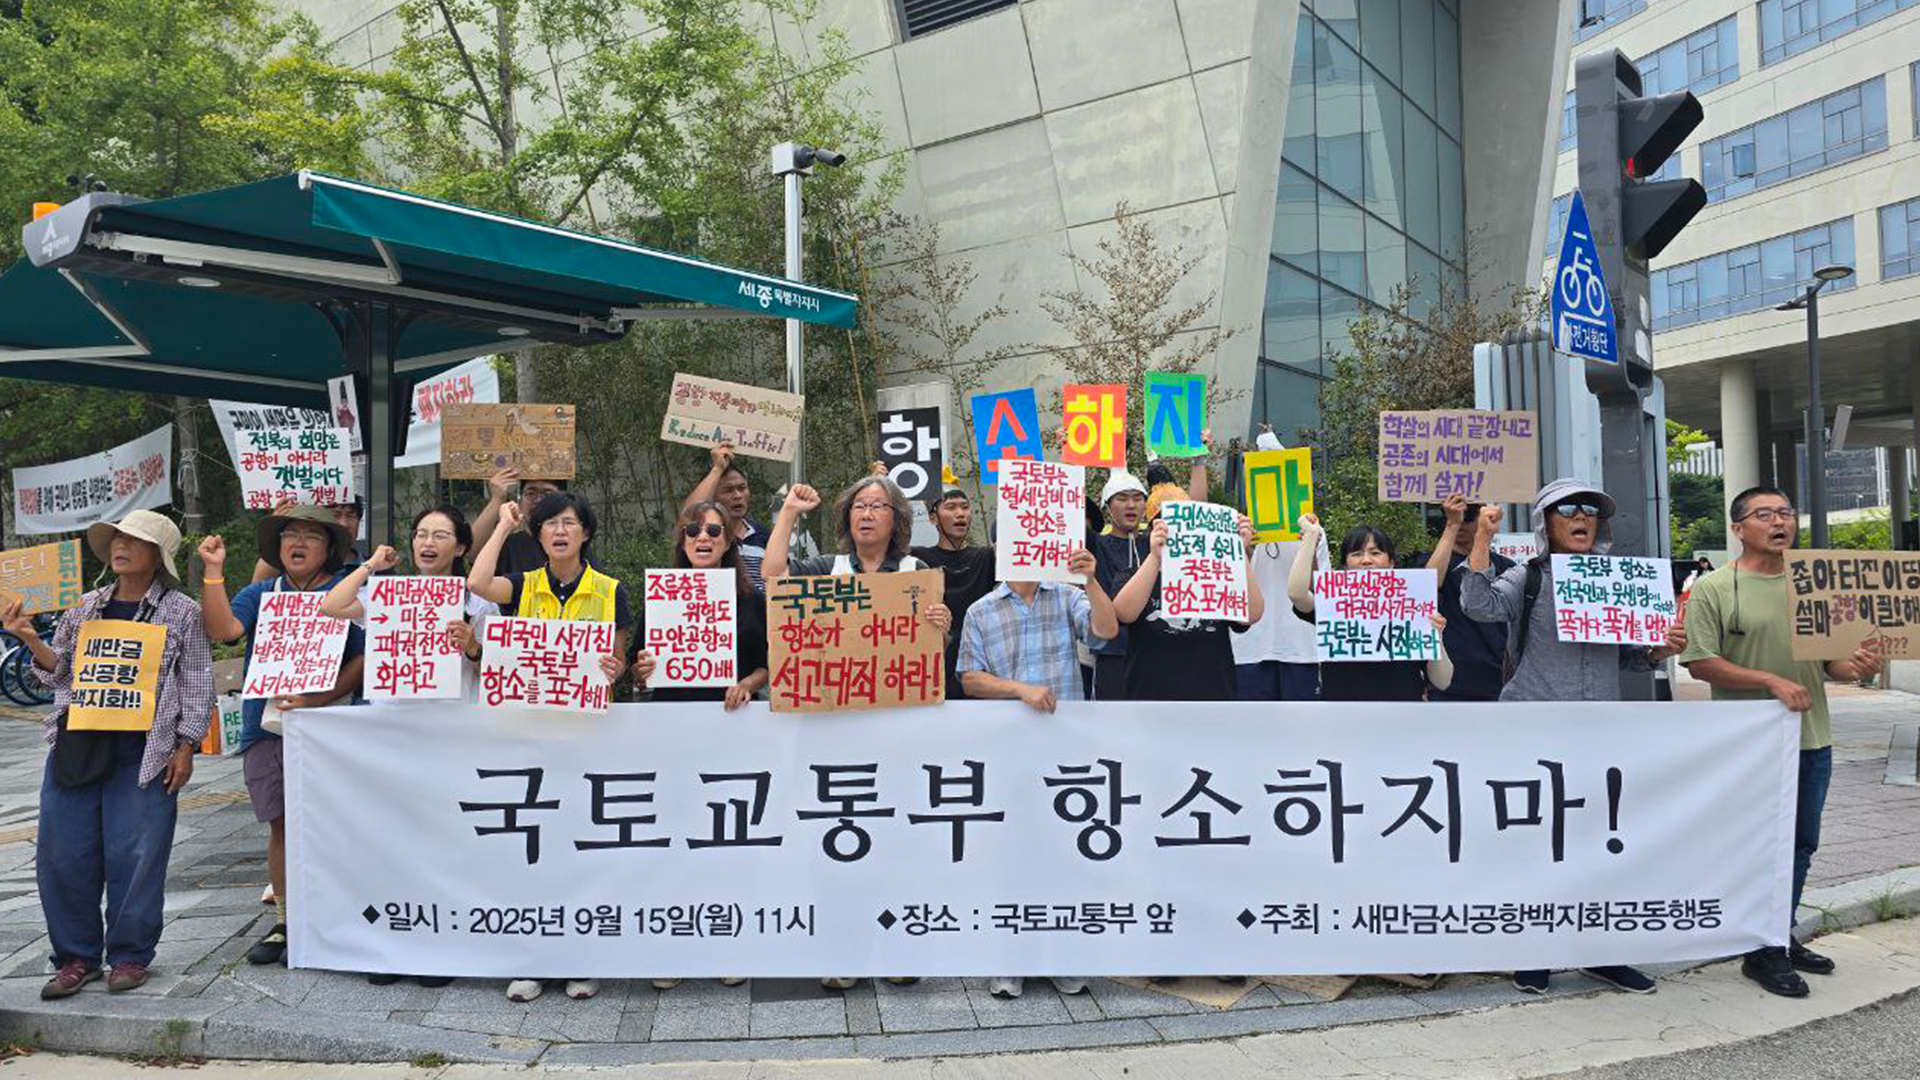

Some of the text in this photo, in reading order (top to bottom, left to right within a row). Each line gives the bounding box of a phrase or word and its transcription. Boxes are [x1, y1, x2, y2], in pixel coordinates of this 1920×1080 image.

[1066, 394, 1124, 460] 하
[1150, 380, 1202, 448] 지
[1383, 414, 1533, 439] 학살의 시대 끝장내고
[248, 431, 291, 450] 전북의
[298, 431, 340, 450] 희망은
[668, 418, 709, 442] Reduce
[736, 429, 786, 454] Traffic!
[986, 398, 1034, 472] 소
[240, 450, 327, 470] 공항이 아니라
[881, 413, 940, 498] 항
[1382, 443, 1504, 467] 공존의 시대에서
[272, 465, 343, 489] 갯벌이다
[1010, 461, 1068, 486] 국토부는
[1384, 471, 1485, 499] 함께 살자!
[999, 483, 1064, 510] 혈세낭비
[1250, 459, 1309, 533] 마
[1016, 508, 1067, 538] 항소를
[1166, 533, 1244, 561] 압도적 승리!
[1180, 559, 1234, 582] 국토부는
[1567, 555, 1658, 580] 국토부 항소는
[371, 578, 463, 606] 새만금신공항
[647, 573, 708, 600] 조류충돌
[772, 576, 872, 619] 국토부는
[1315, 571, 1408, 599] 새만금신공항은
[1556, 578, 1610, 604] 전국민과
[682, 600, 732, 624] 위험도
[1602, 606, 1642, 642] 폭거를
[1795, 599, 1832, 637] 설마
[487, 619, 612, 653] 대국민 사기친
[647, 625, 732, 656] 무안공항의
[779, 613, 920, 653] 항소가 아니라
[1317, 620, 1440, 660] 국토부는 사죄하라
[83, 638, 142, 659] 새만금
[254, 638, 325, 664] 발전시키지
[79, 664, 139, 685] 신공항
[294, 654, 340, 675] 않는다!
[373, 657, 437, 695] 화약고
[517, 650, 579, 677] 국토부
[666, 657, 733, 682] 650배
[245, 670, 336, 695] 사기치지 마!
[482, 664, 610, 709] 항소를 포기해!
[772, 652, 941, 708] 석고대죄 하라!
[71, 689, 141, 709] 백지화!!
[459, 758, 1626, 865] 국토교통부 항소하지마!
[384, 902, 439, 934] 일시
[469, 905, 565, 936] 2025년
[575, 904, 623, 936] 9월
[635, 903, 743, 938] 15일(월)
[755, 904, 816, 936] 11시
[901, 903, 960, 936] 장소
[991, 903, 1137, 934] 국토교통부
[1146, 903, 1177, 934] 앞
[1260, 902, 1320, 935] 주최
[1352, 898, 1722, 935] 새만금신공항백지화공동행동
